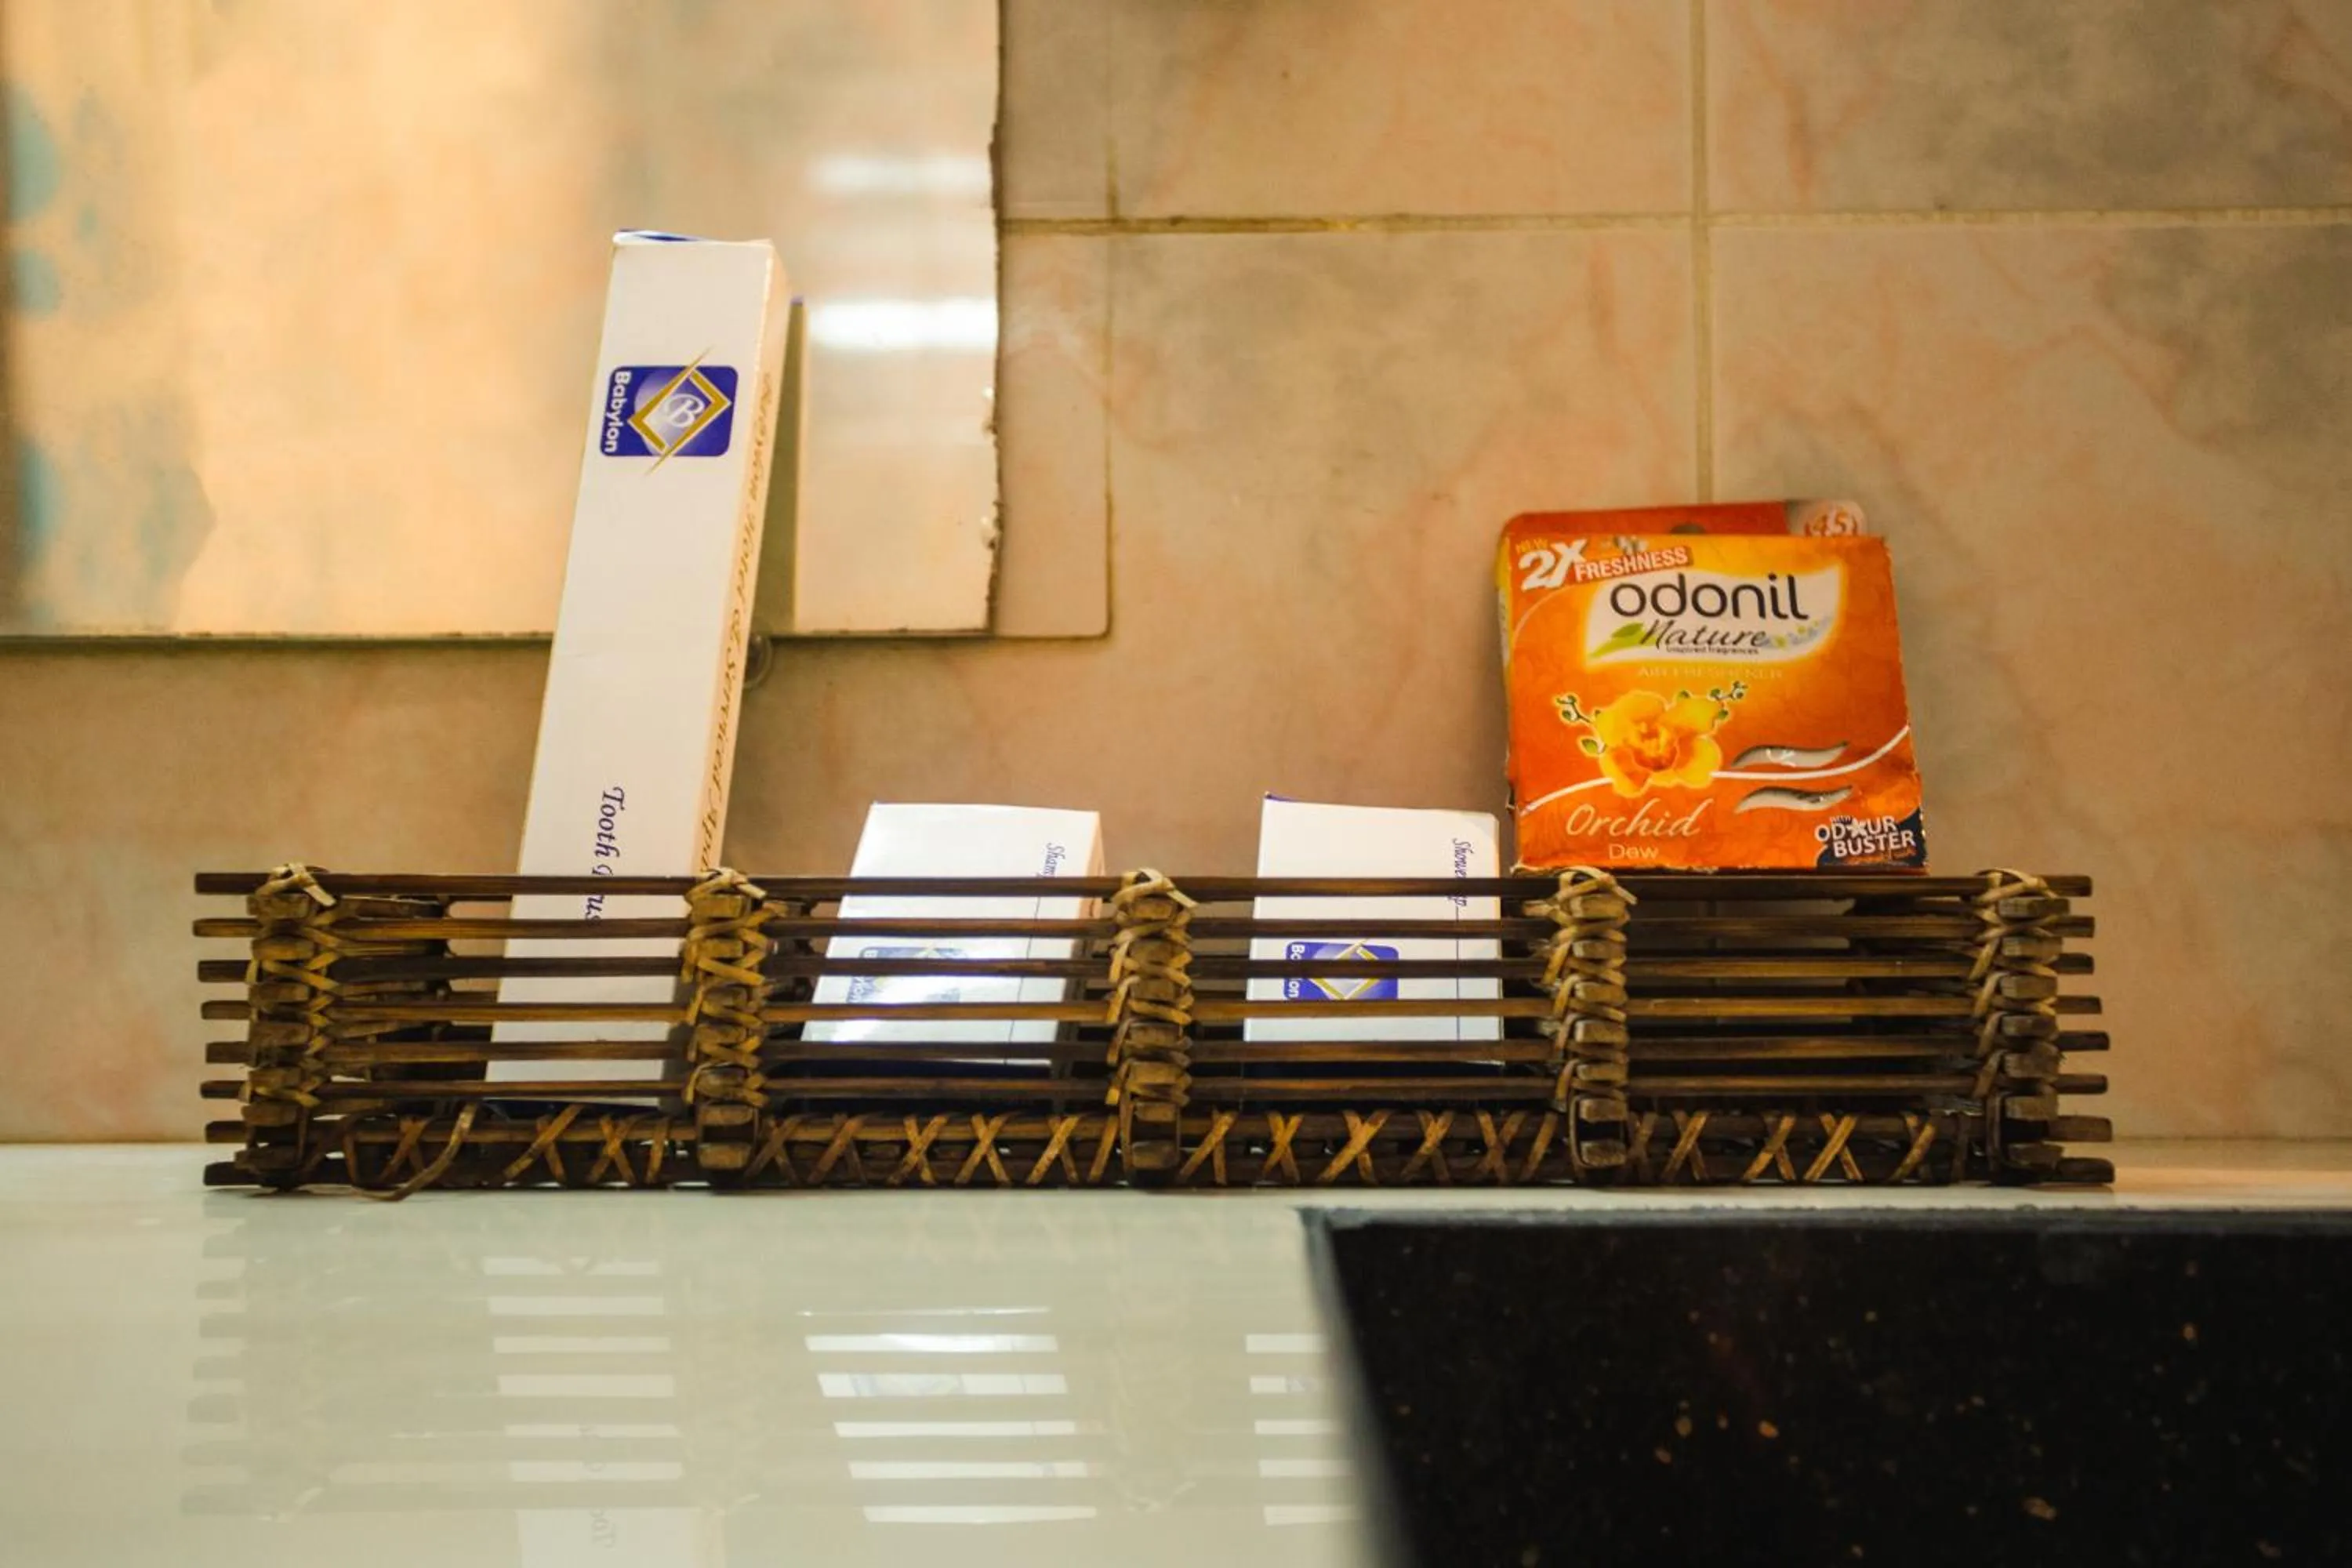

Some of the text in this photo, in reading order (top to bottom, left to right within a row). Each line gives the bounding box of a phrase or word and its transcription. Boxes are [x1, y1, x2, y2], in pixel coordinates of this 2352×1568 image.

[604, 371, 631, 452] Babylon
[1518, 539, 1689, 592] 2X FRESHNESS
[1610, 572, 1809, 620] odonil
[1640, 618, 1767, 649] Nature
[594, 786, 625, 858] Tooth
[1566, 797, 1715, 837] Orchid
[1036, 842, 1066, 877] Sham
[1453, 838, 1474, 879] Showe
[1609, 843, 1659, 860] Dew
[1833, 829, 1916, 858] BUSTER
